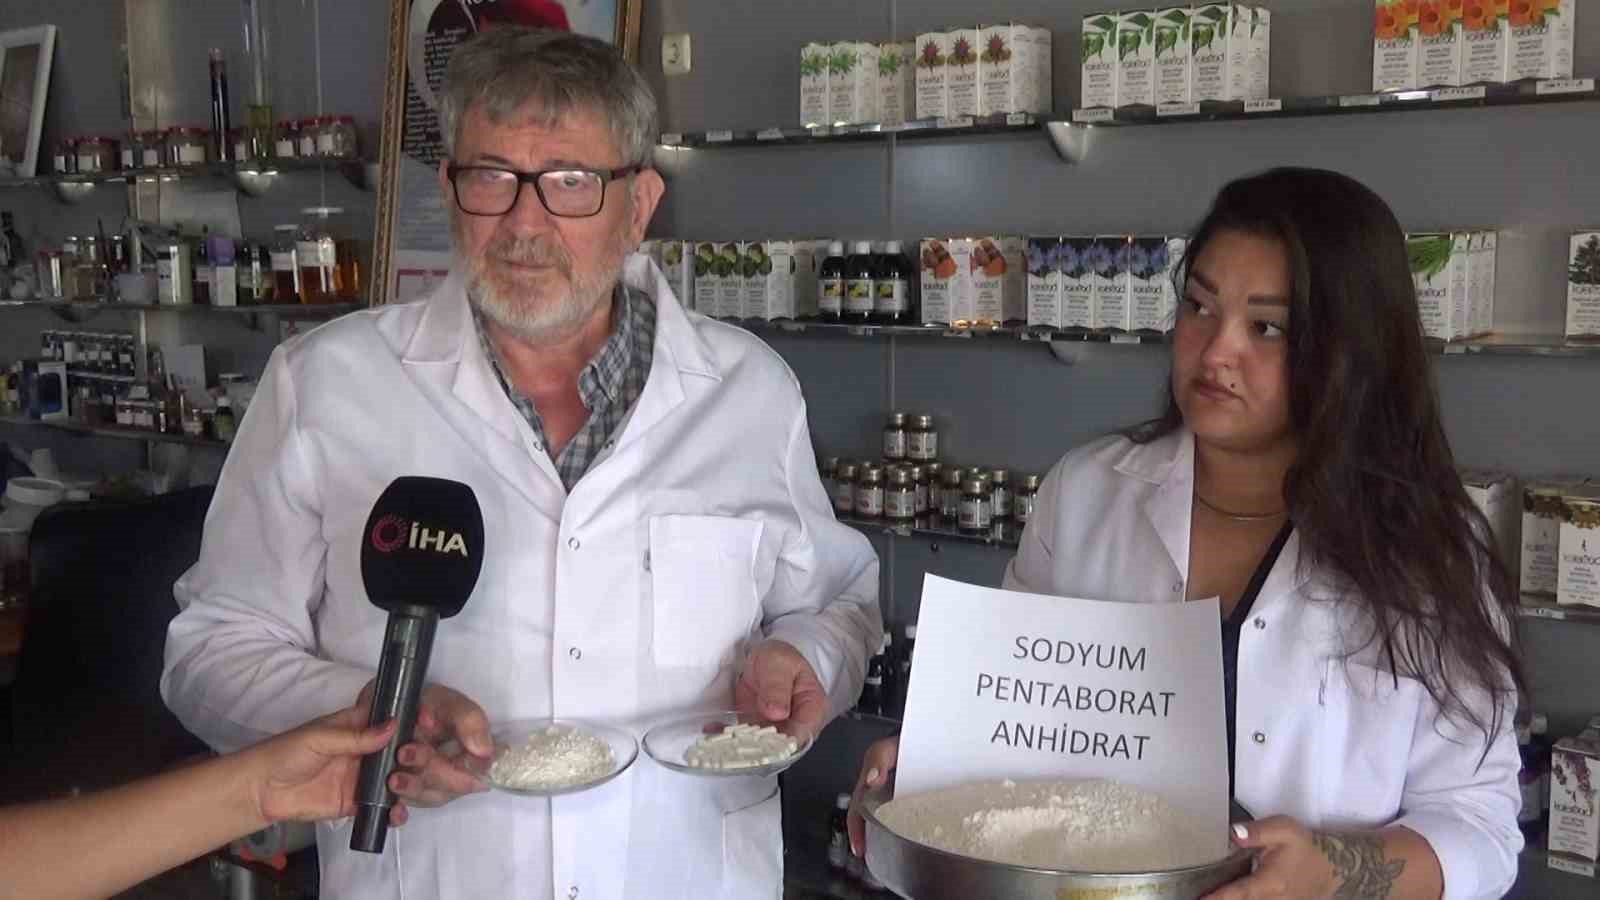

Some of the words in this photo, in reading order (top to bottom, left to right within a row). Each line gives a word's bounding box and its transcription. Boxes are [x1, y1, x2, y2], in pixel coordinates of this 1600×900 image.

[409, 521, 468, 557] İHA
[1013, 635, 1147, 672] SODYUM
[976, 672, 1177, 718] PENTABORAT
[991, 720, 1151, 761] ANHİDRAT
